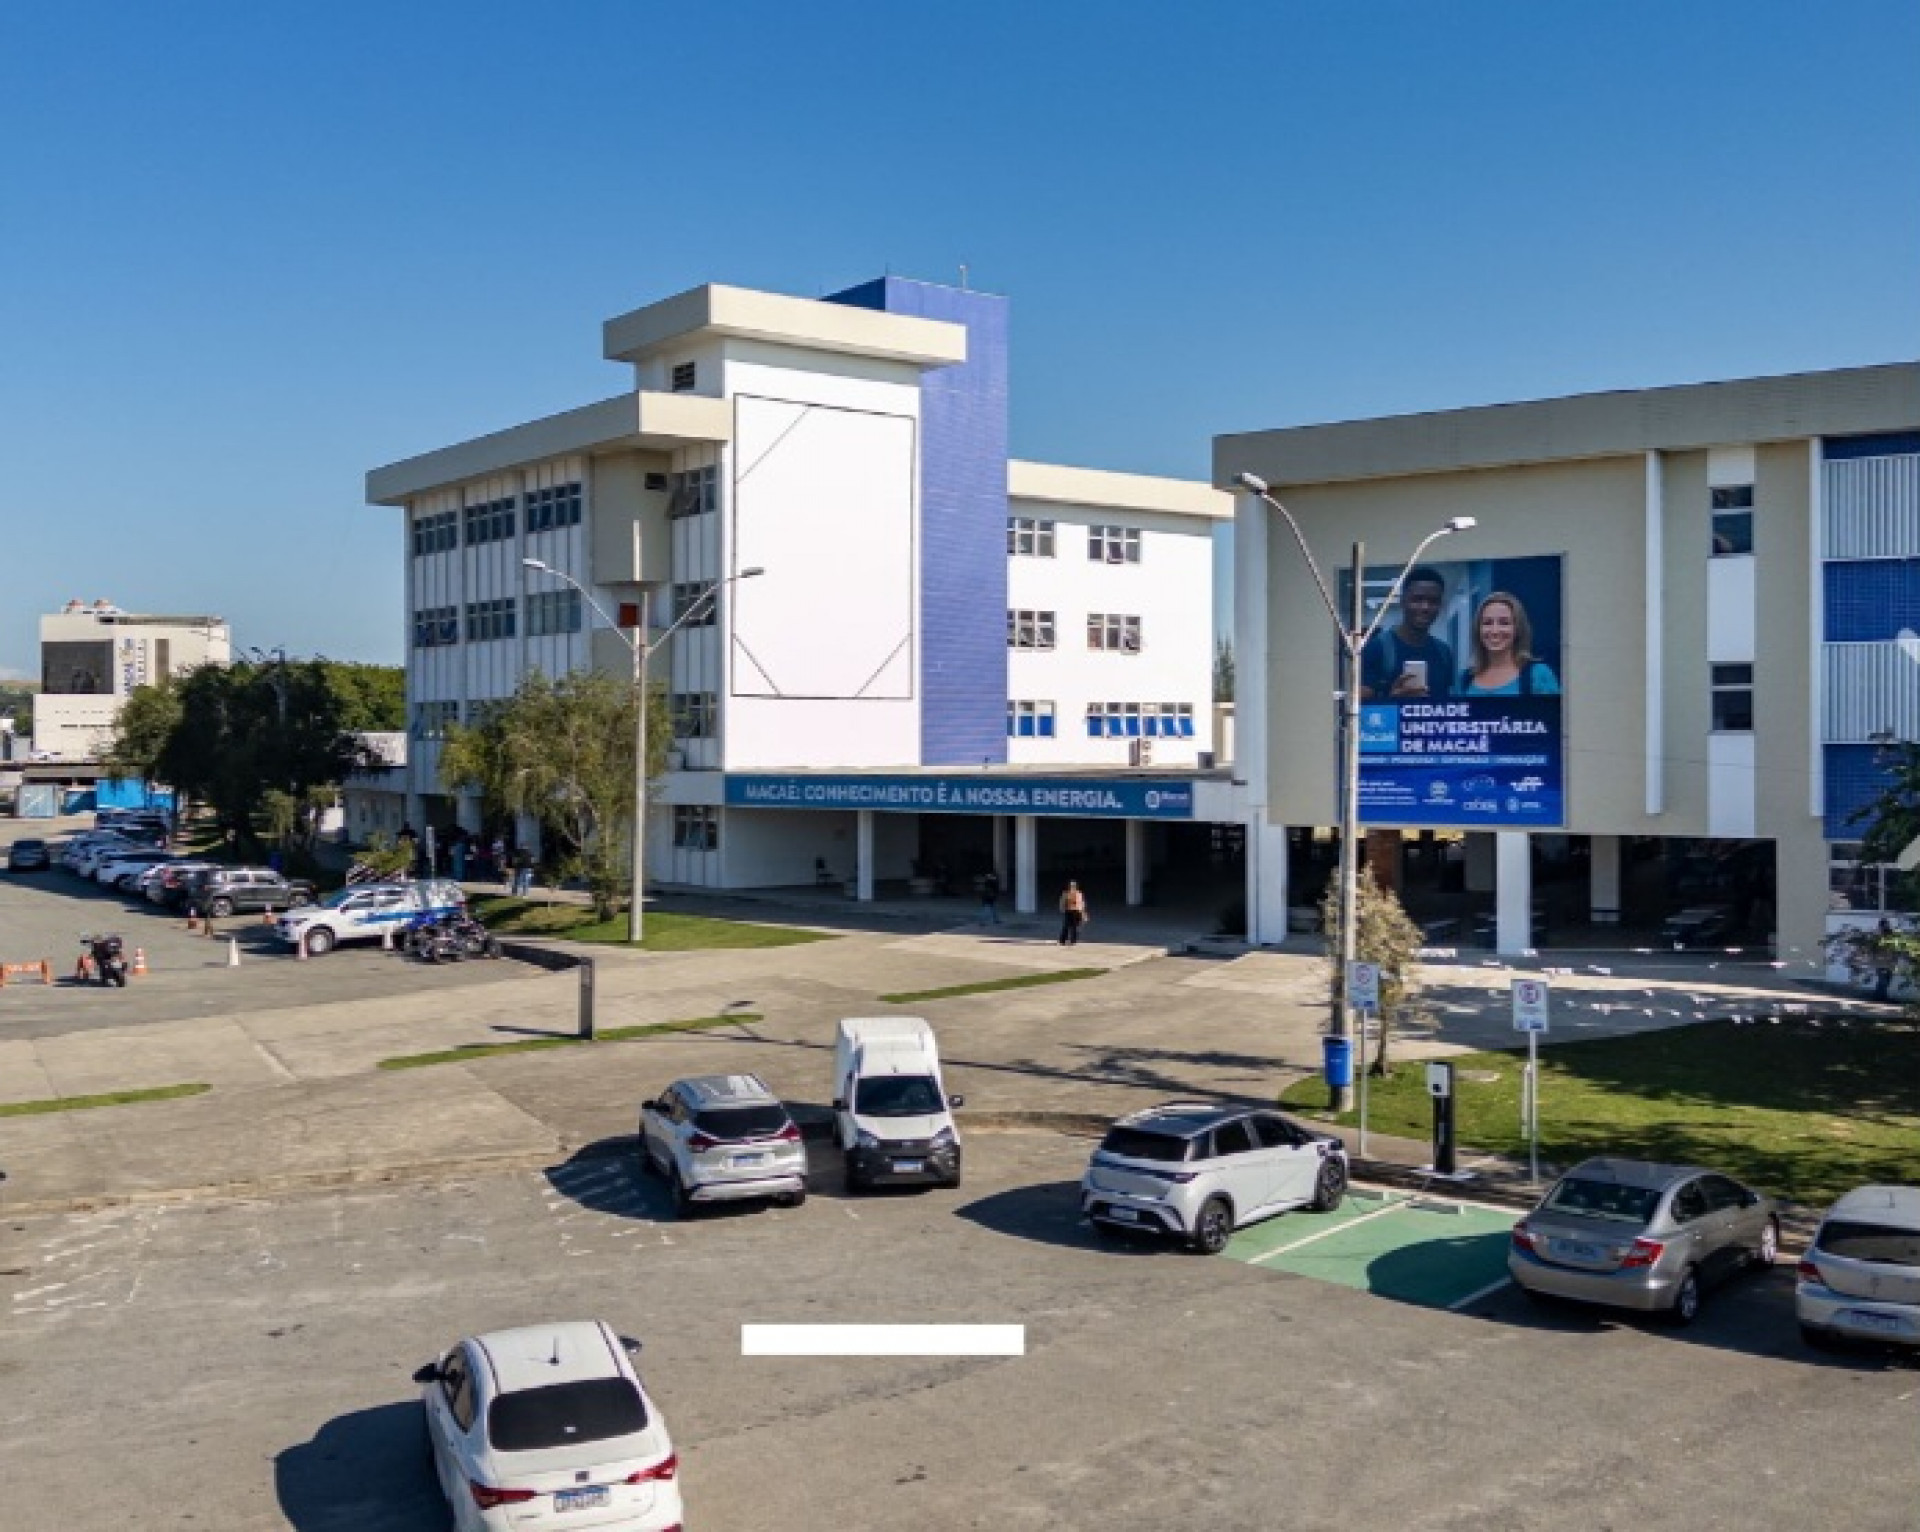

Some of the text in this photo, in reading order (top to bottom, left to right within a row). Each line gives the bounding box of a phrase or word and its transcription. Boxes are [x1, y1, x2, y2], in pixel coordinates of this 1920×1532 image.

[1401, 703, 1470, 717] CIDADE
[1401, 716, 1547, 734] UNIVERSITÁRIA
[1401, 737, 1425, 752] DE
[1427, 735, 1490, 752] MACAÉ
[804, 784, 933, 803] CONHECIMENTO
[937, 781, 948, 804] É
[951, 787, 963, 804] A
[966, 788, 1028, 805] NOSSA
[1032, 788, 1123, 808] ENERGIA.
